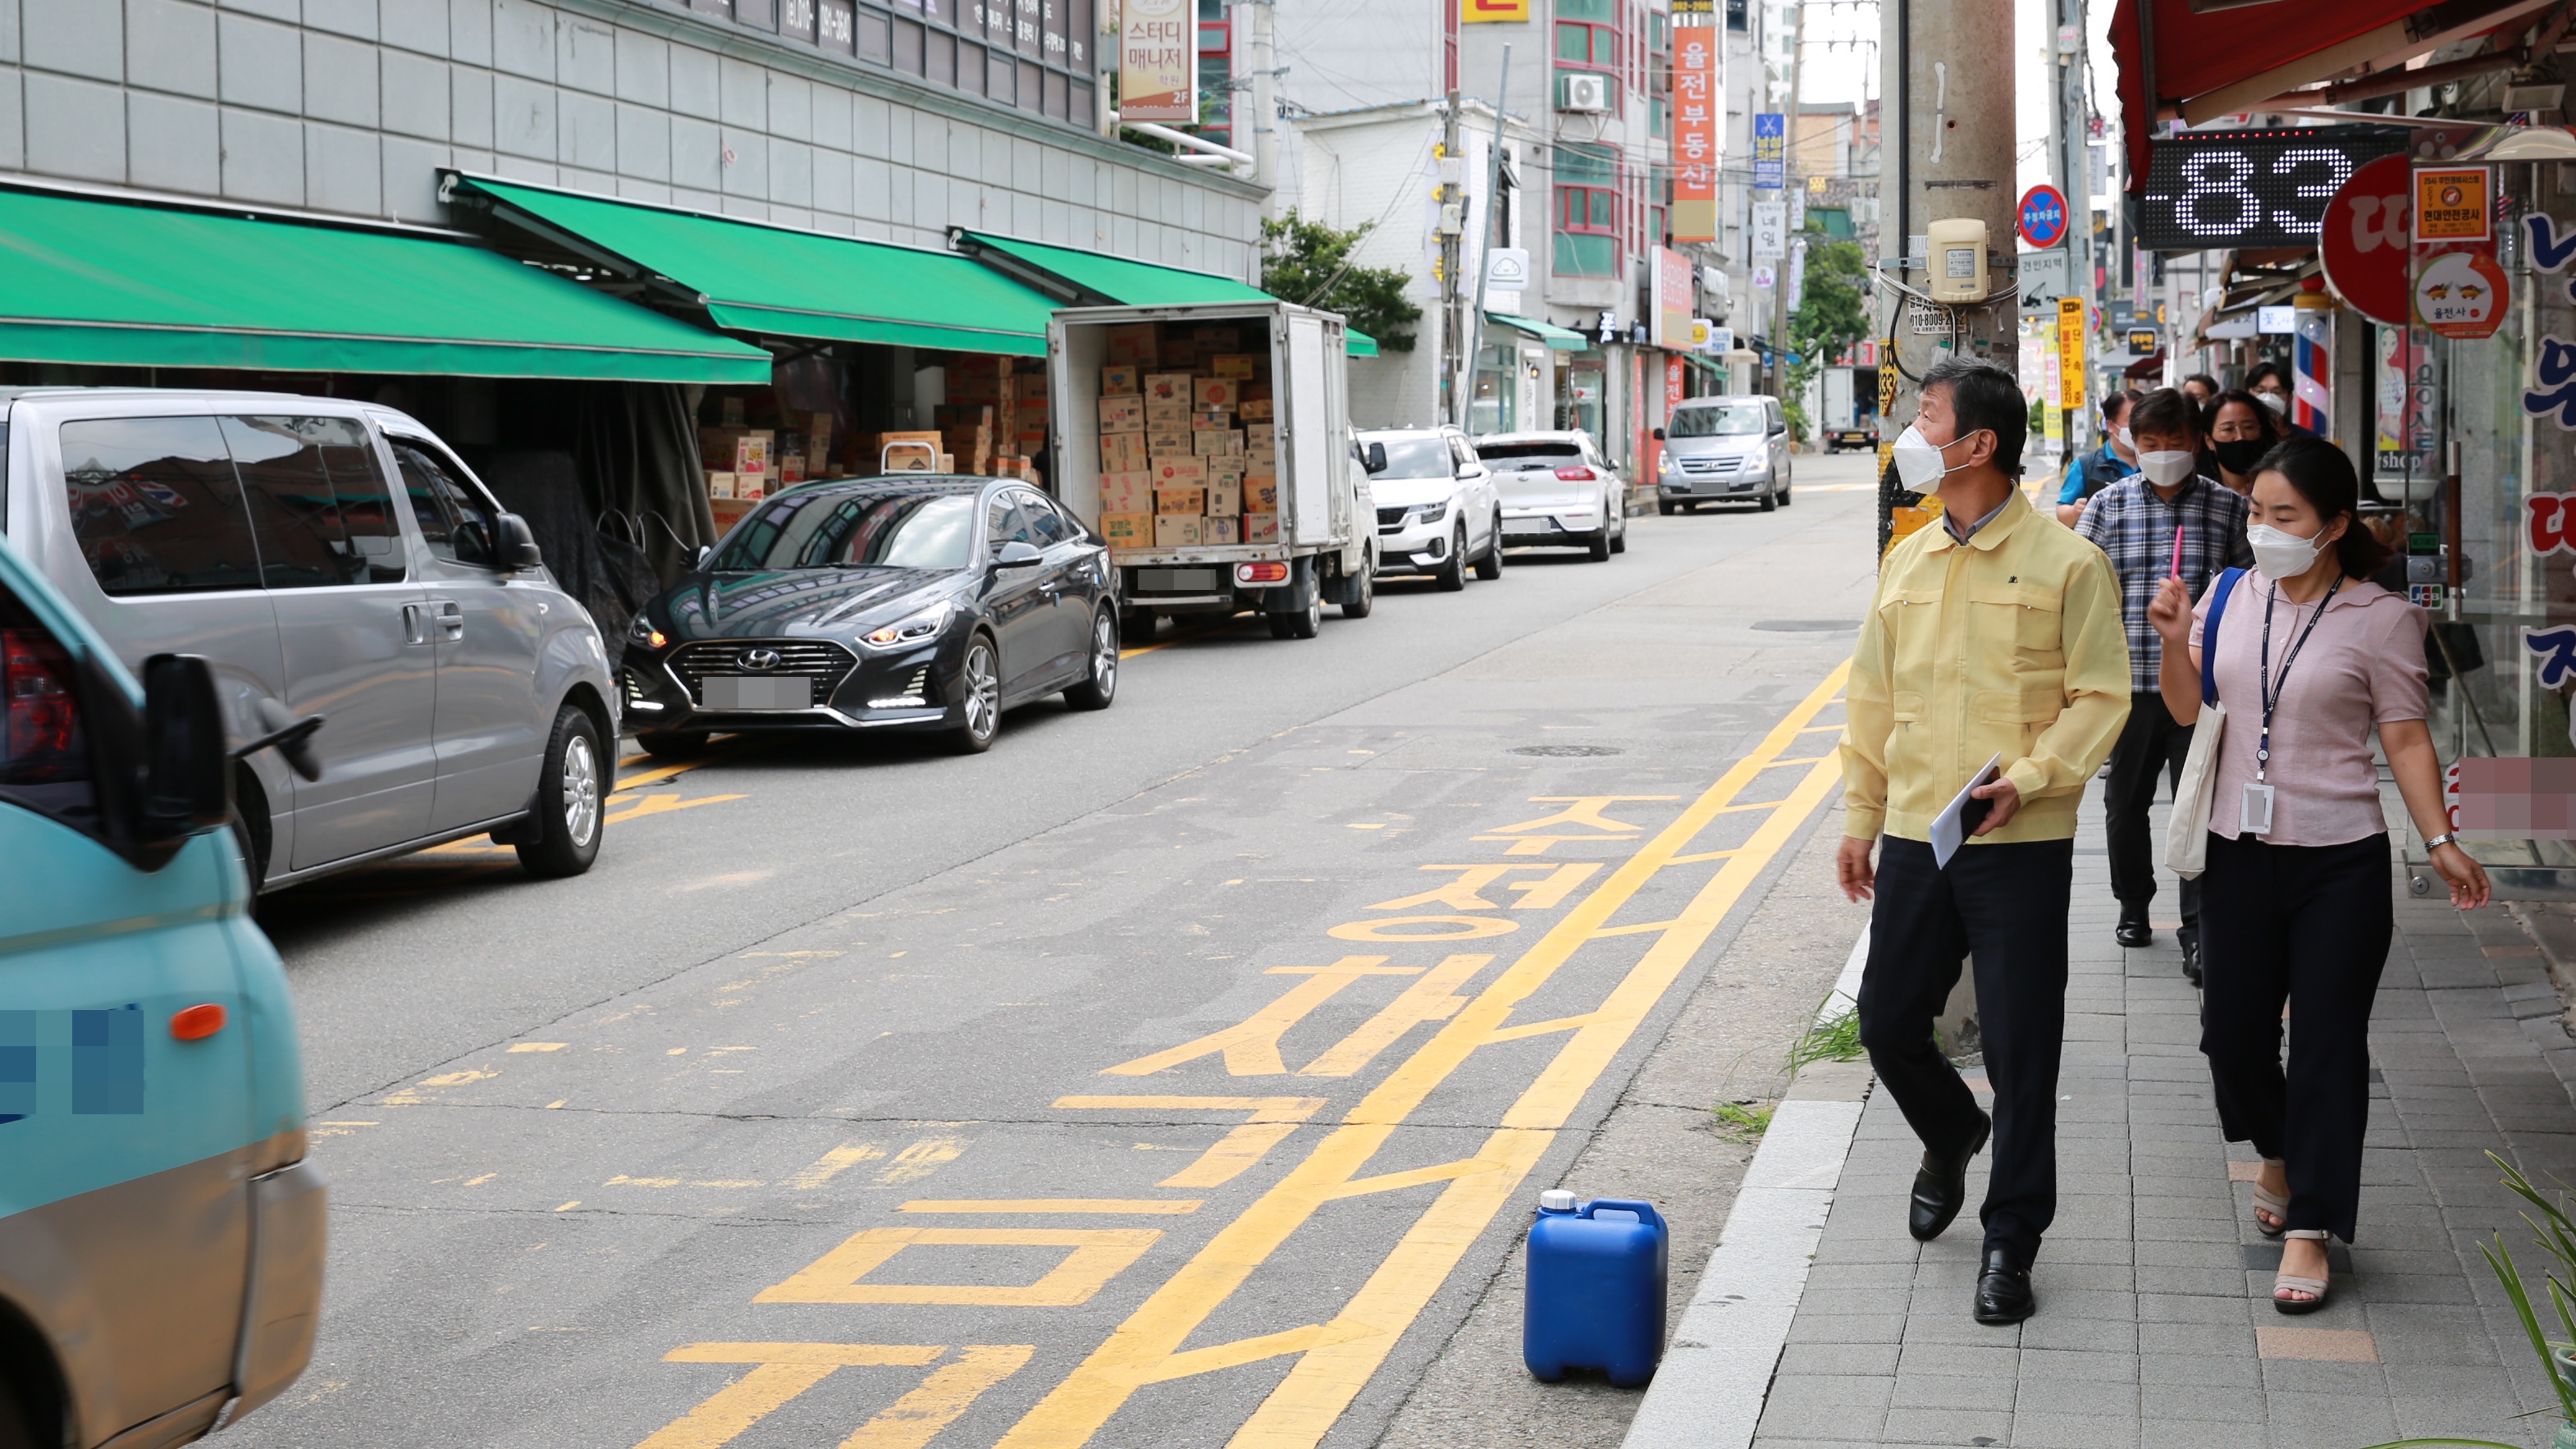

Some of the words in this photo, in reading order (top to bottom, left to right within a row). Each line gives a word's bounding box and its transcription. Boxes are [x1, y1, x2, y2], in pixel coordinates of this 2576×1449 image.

[1128, 21, 1181, 43] 스터디
[1128, 48, 1181, 71] 매니저
[1173, 90, 1189, 104] 2F
[1680, 42, 1710, 190] 율전부동산
[2023, 208, 2061, 224] 주정차금지
[2423, 208, 2480, 222] 현대안전공사
[2022, 257, 2062, 272] 견인지역
[2062, 316, 2080, 326] CCTV
[2411, 592, 2440, 601] JCB
